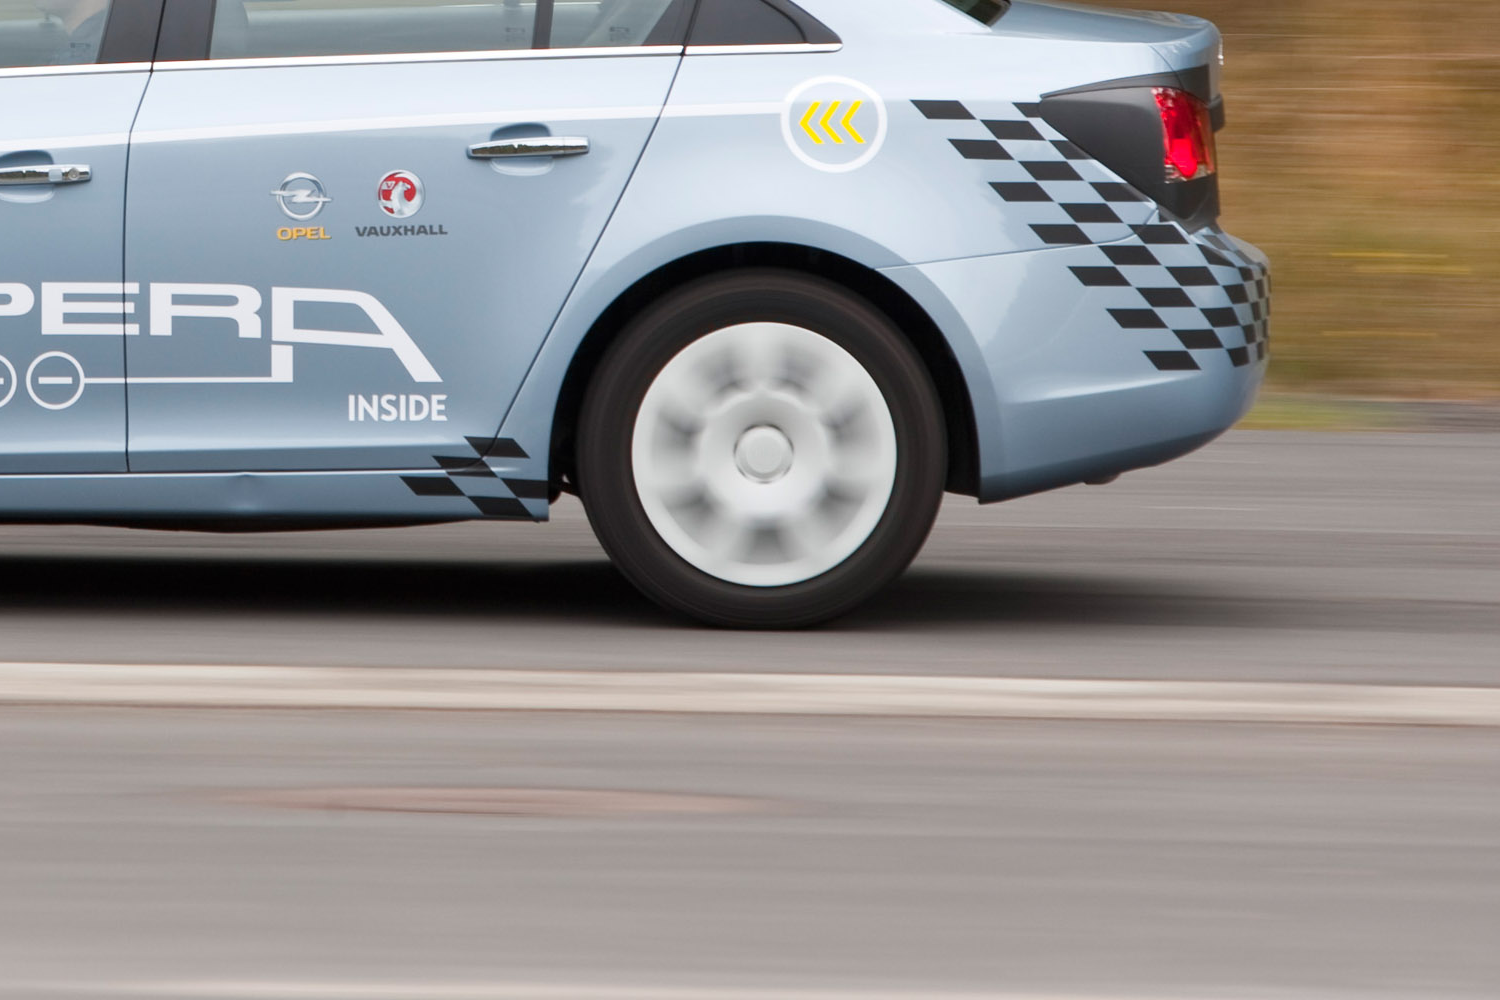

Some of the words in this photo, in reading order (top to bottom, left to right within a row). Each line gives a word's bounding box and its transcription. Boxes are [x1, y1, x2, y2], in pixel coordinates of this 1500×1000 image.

[276, 226, 332, 241] OPEL
[355, 224, 448, 238] VAUXHALL
[348, 393, 448, 422] INSIDE
